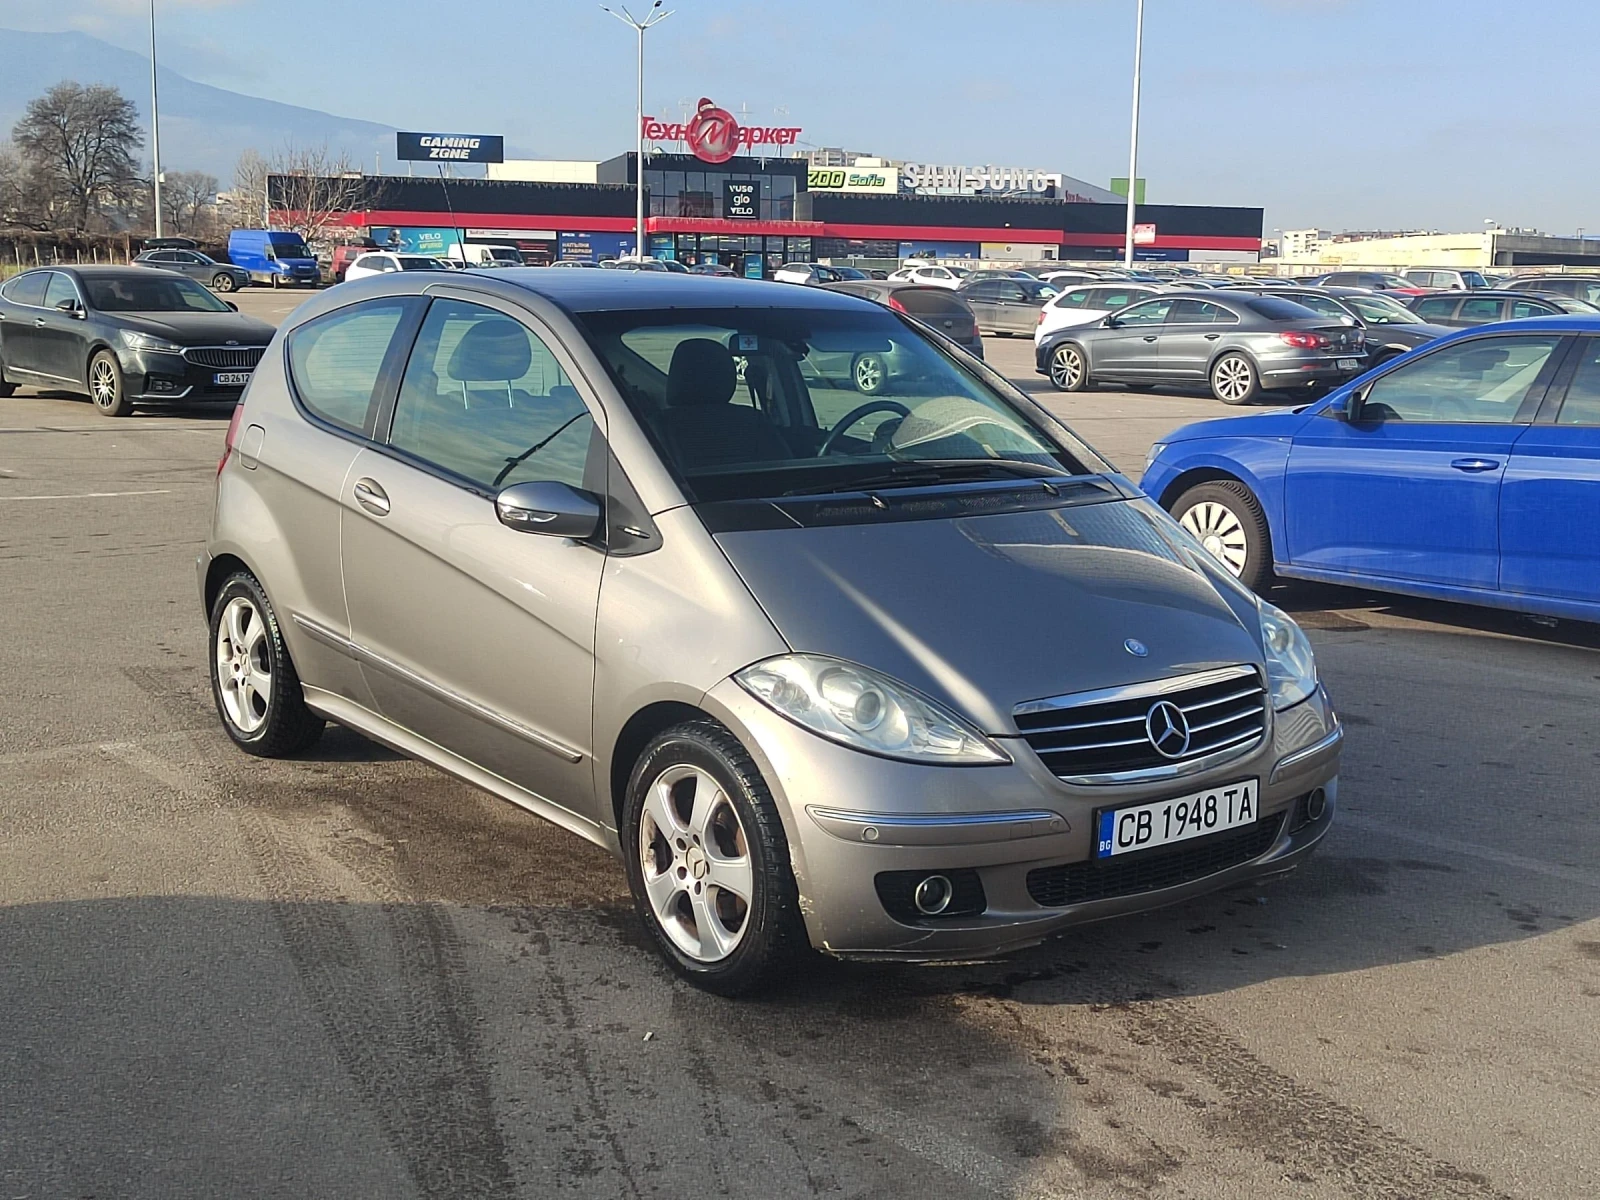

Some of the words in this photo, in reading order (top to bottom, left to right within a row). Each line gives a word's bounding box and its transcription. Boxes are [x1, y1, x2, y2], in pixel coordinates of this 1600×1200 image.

[420, 136, 480, 148] GAMING
[808, 171, 846, 188] ZOO
[848, 174, 885, 187] Sofia
[903, 163, 1048, 192] SAMSUNG
[733, 194, 750, 206] glo
[730, 207, 753, 215] VELO
[219, 374, 230, 383] CB
[1118, 810, 1152, 848] CB
[1162, 795, 1217, 839] 1948
[1224, 787, 1252, 823] TA
[1100, 840, 1111, 851] BG
